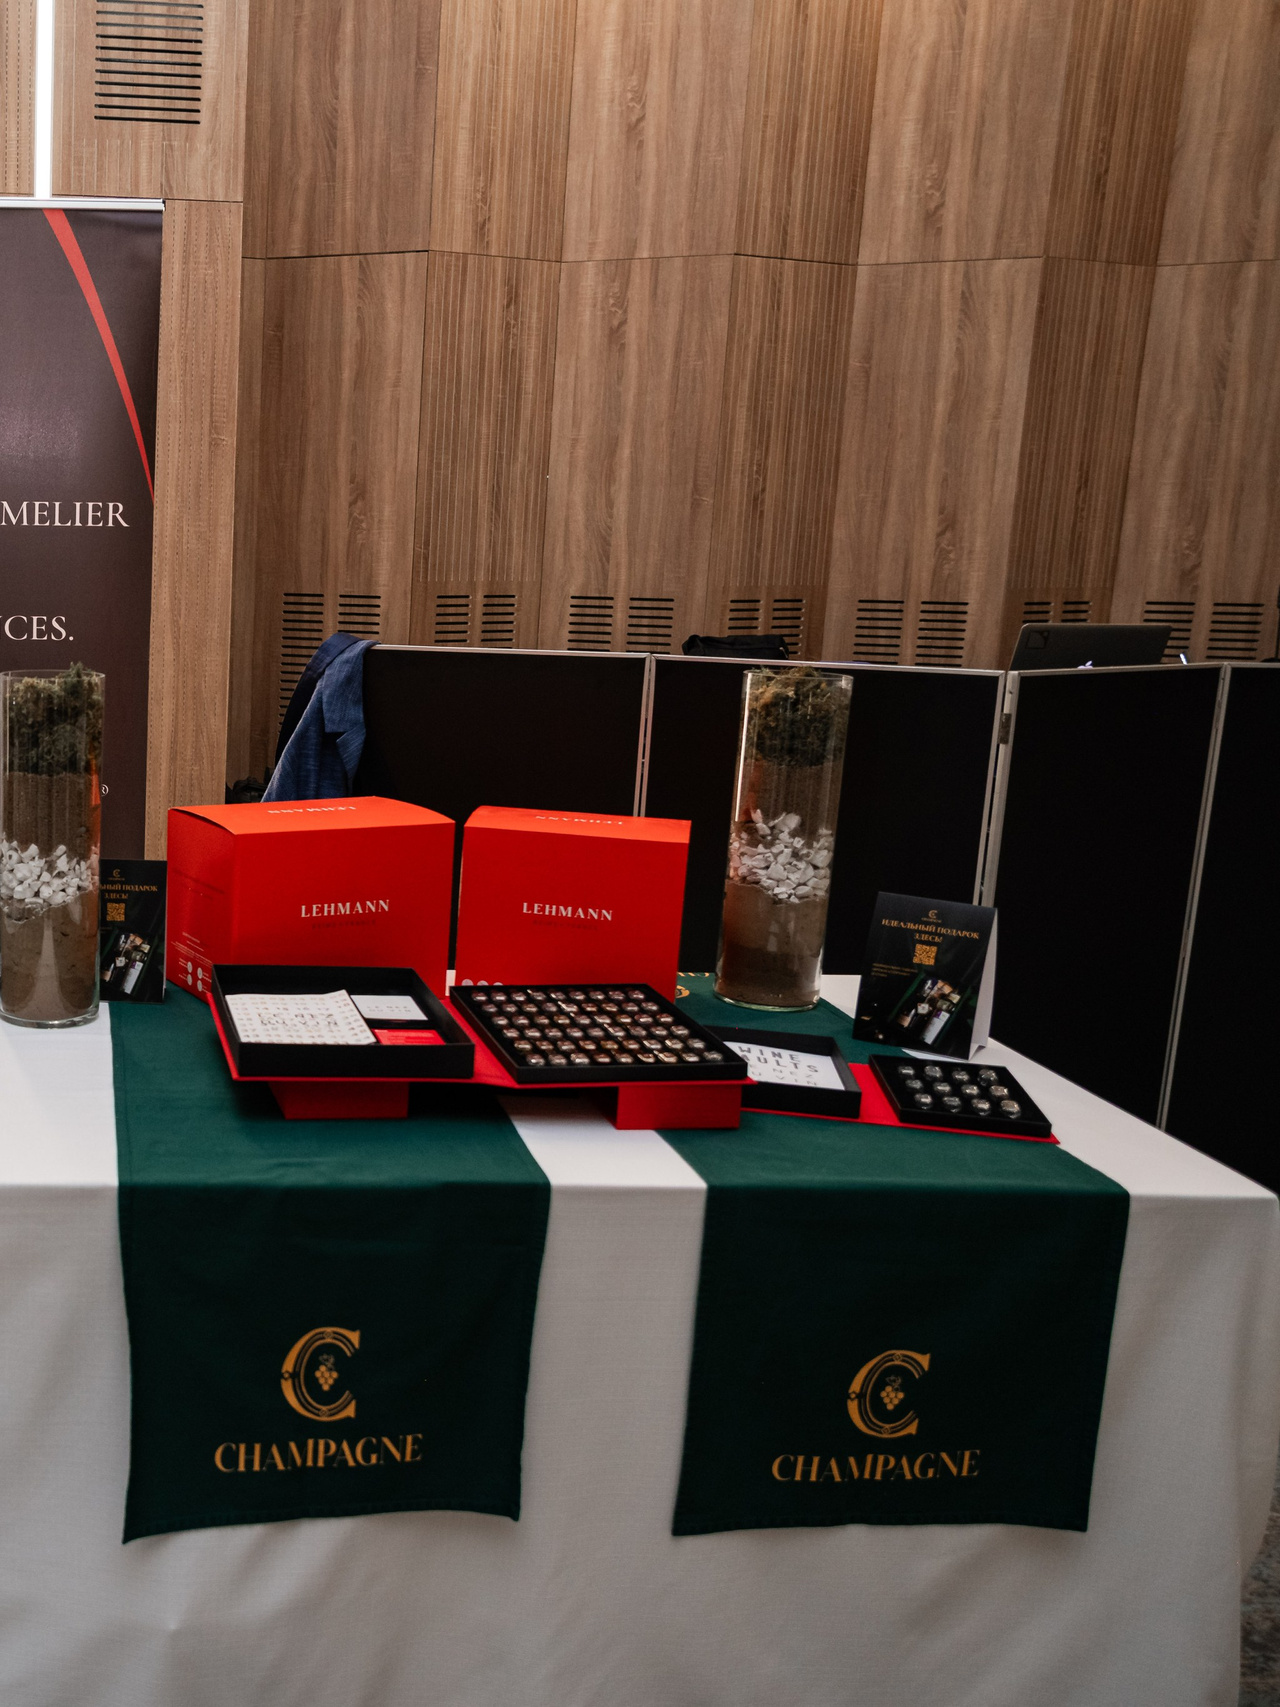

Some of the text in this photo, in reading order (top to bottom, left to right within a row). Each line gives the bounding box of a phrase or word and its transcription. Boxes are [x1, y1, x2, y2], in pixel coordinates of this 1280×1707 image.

[301, 899, 389, 918] LEHMANN
[523, 902, 613, 921] LEHMANN
[881, 919, 979, 939] ИДЕАЛЬНЫЙ ПОДАРОК
[738, 1046, 800, 1062] WINE
[741, 1054, 819, 1073] AULTS
[215, 1433, 423, 1473] CHAMPAGNE
[771, 1449, 981, 1483] CHAMPAGNE
